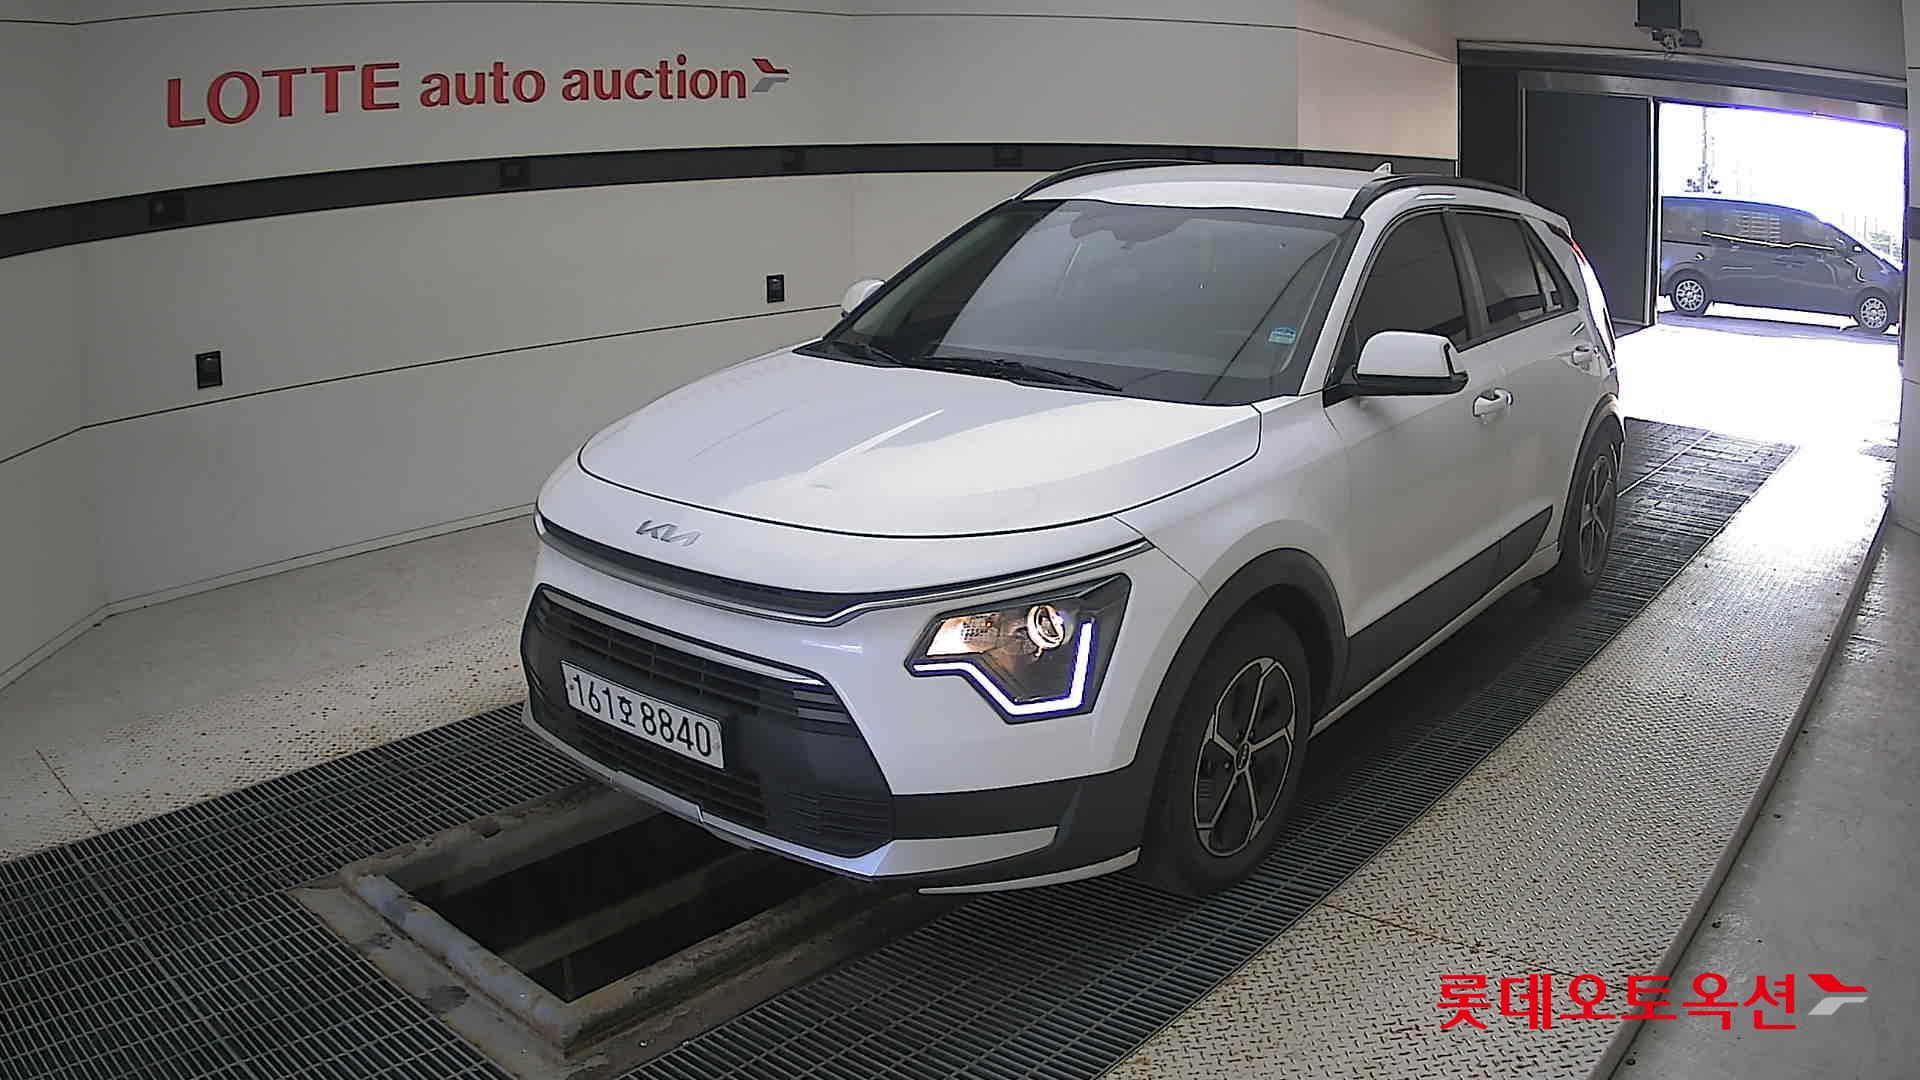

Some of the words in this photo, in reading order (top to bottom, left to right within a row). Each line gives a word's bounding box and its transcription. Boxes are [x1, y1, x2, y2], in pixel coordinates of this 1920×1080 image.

[166, 62, 400, 128] LOTTE
[419, 61, 546, 108] auto
[561, 54, 747, 101] auction
